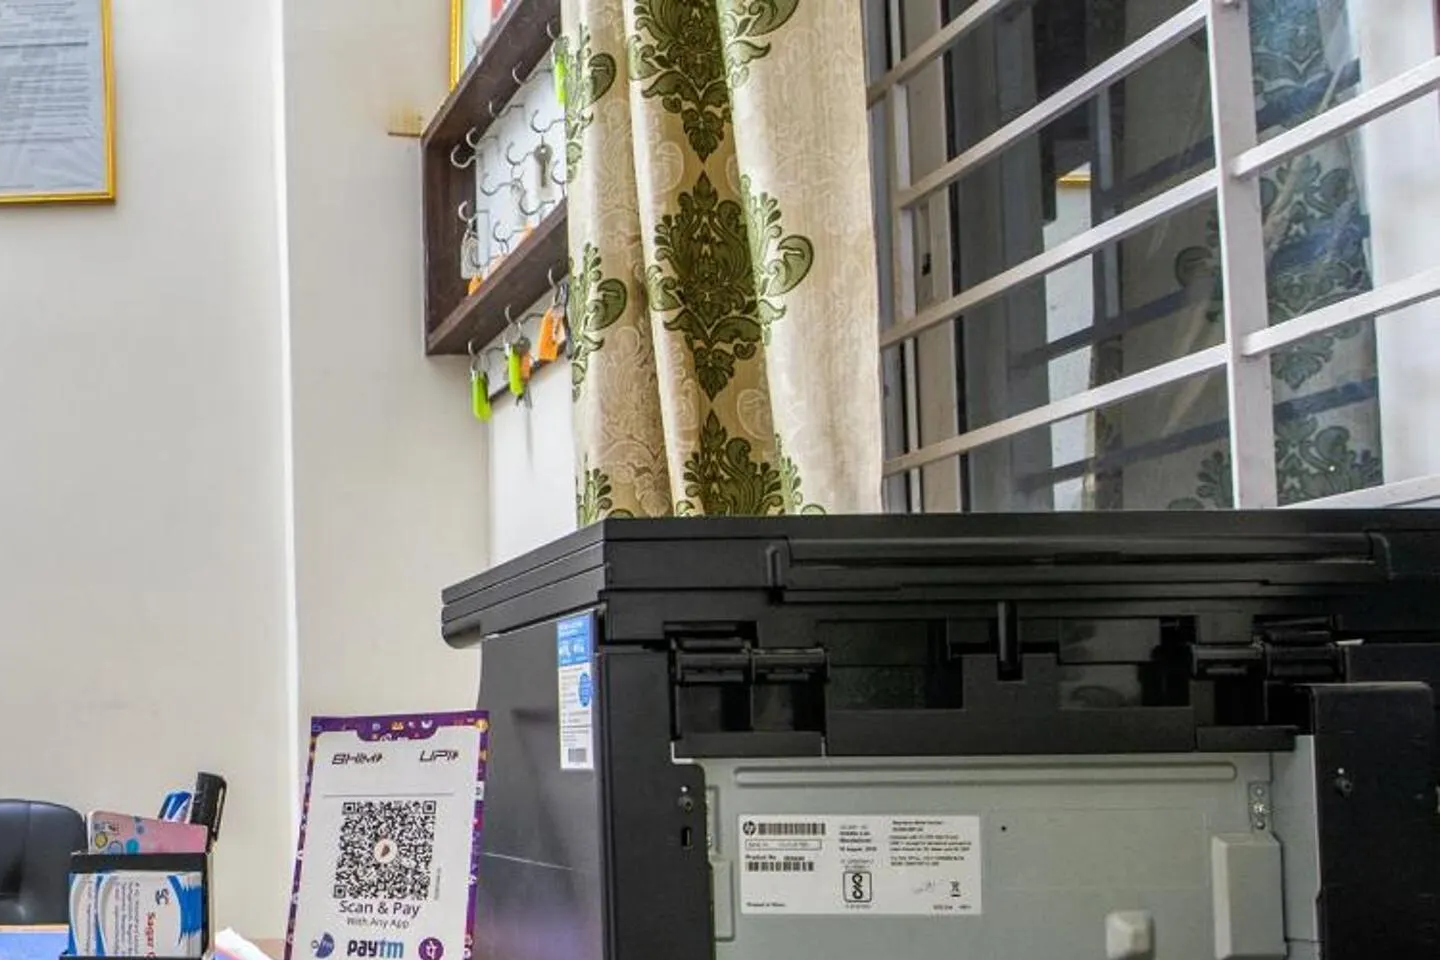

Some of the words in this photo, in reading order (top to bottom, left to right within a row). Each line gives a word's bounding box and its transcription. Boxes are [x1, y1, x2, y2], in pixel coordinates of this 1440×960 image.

[339, 901, 373, 913] Scan
[378, 902, 389, 914] &
[393, 902, 420, 918] Pay
[145, 912, 156, 947] Sagar
[347, 917, 367, 926] With
[371, 918, 387, 928] Any
[390, 919, 409, 929] App
